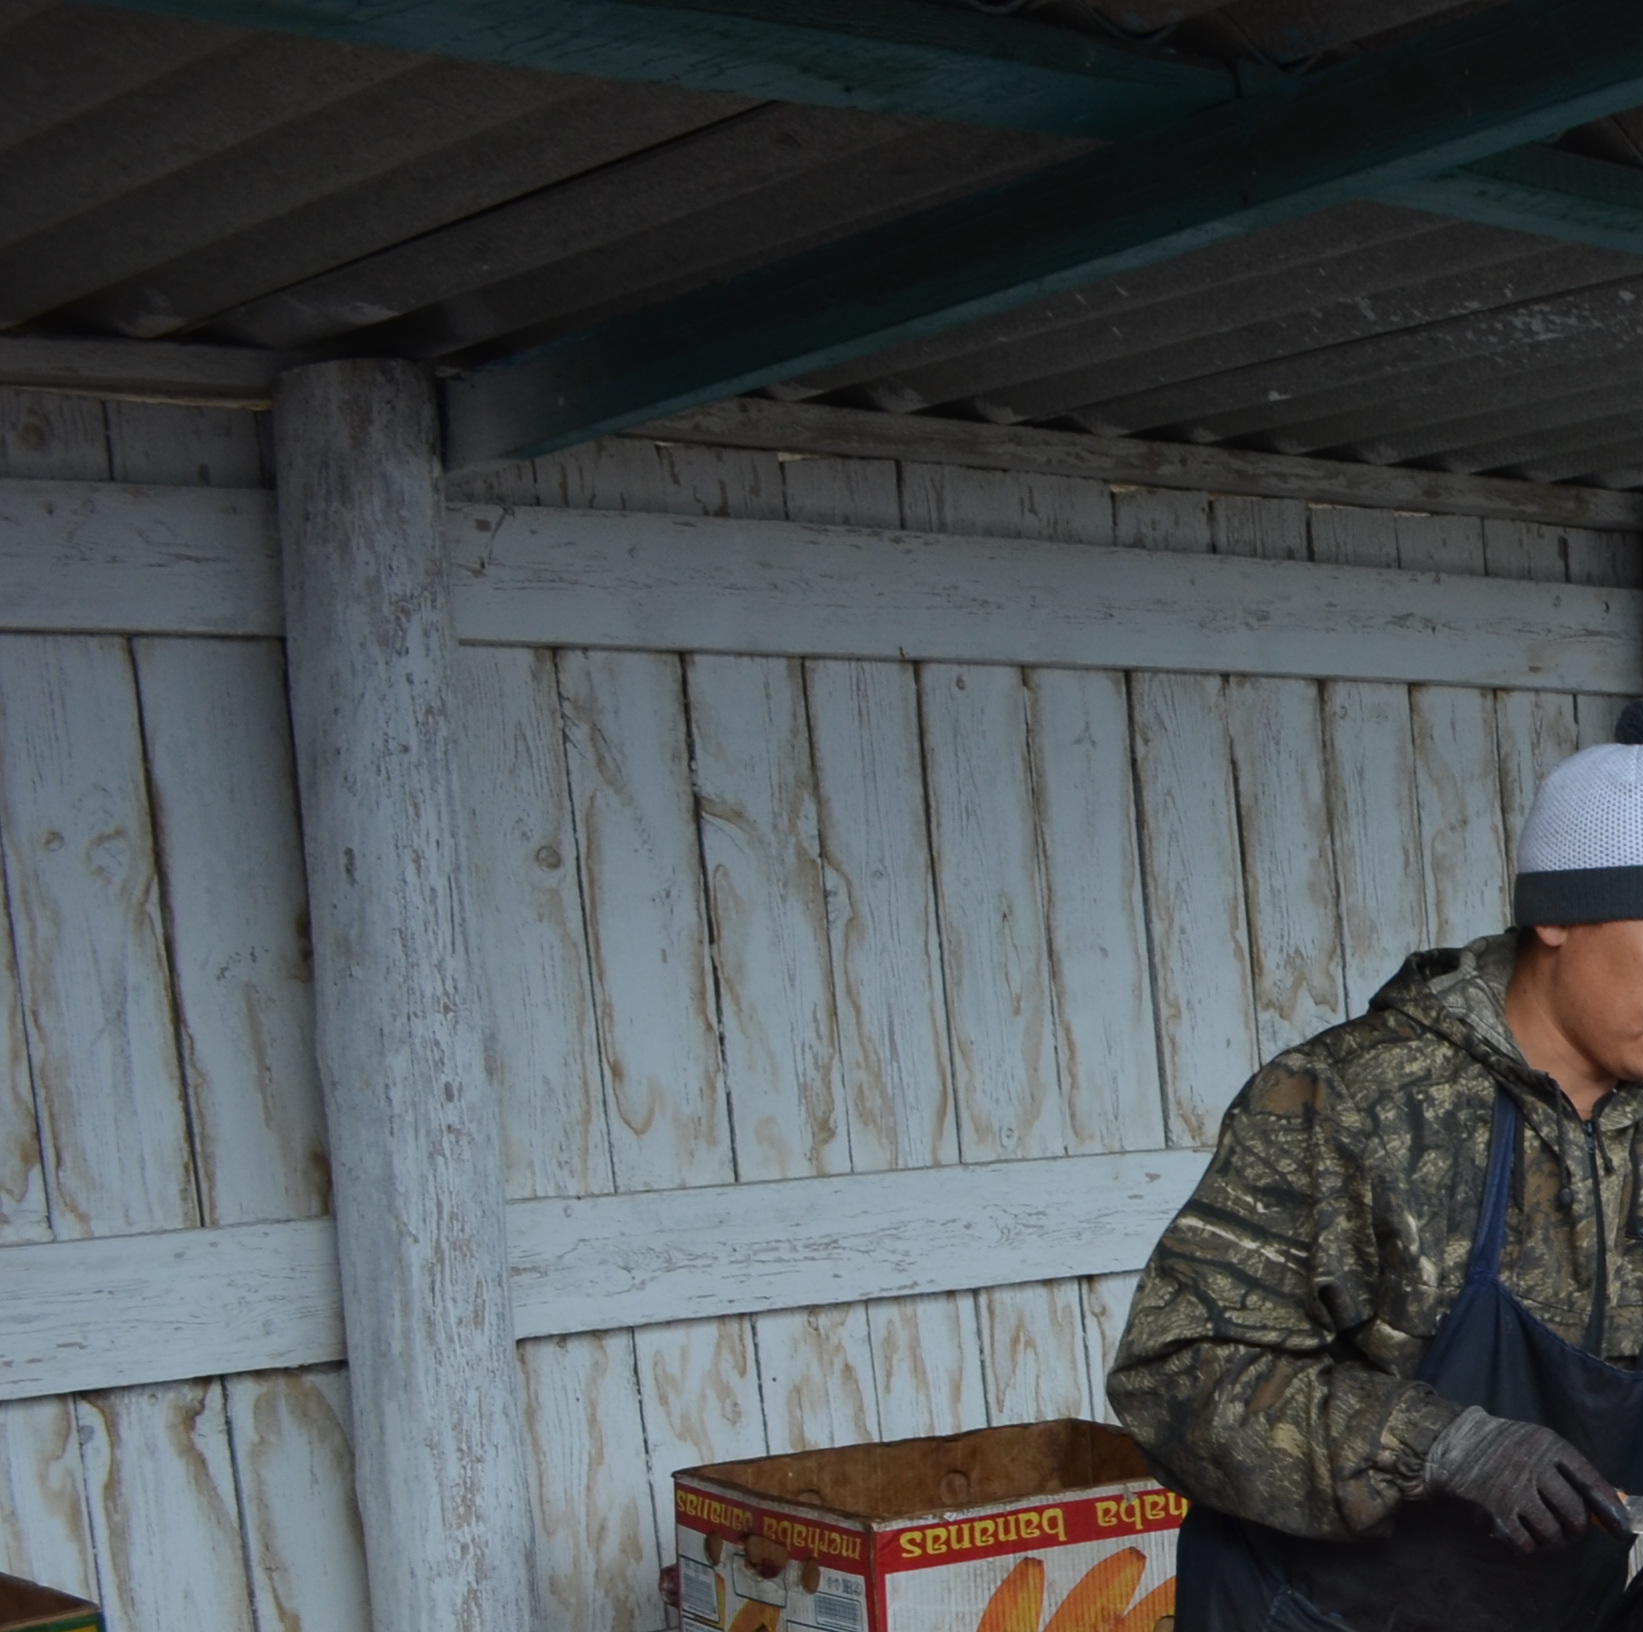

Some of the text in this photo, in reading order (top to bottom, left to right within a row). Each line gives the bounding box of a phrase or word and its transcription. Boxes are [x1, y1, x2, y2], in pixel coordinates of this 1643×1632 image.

[763, 1517, 862, 1560] merhaba
[900, 1490, 1188, 1558] haba bananas
